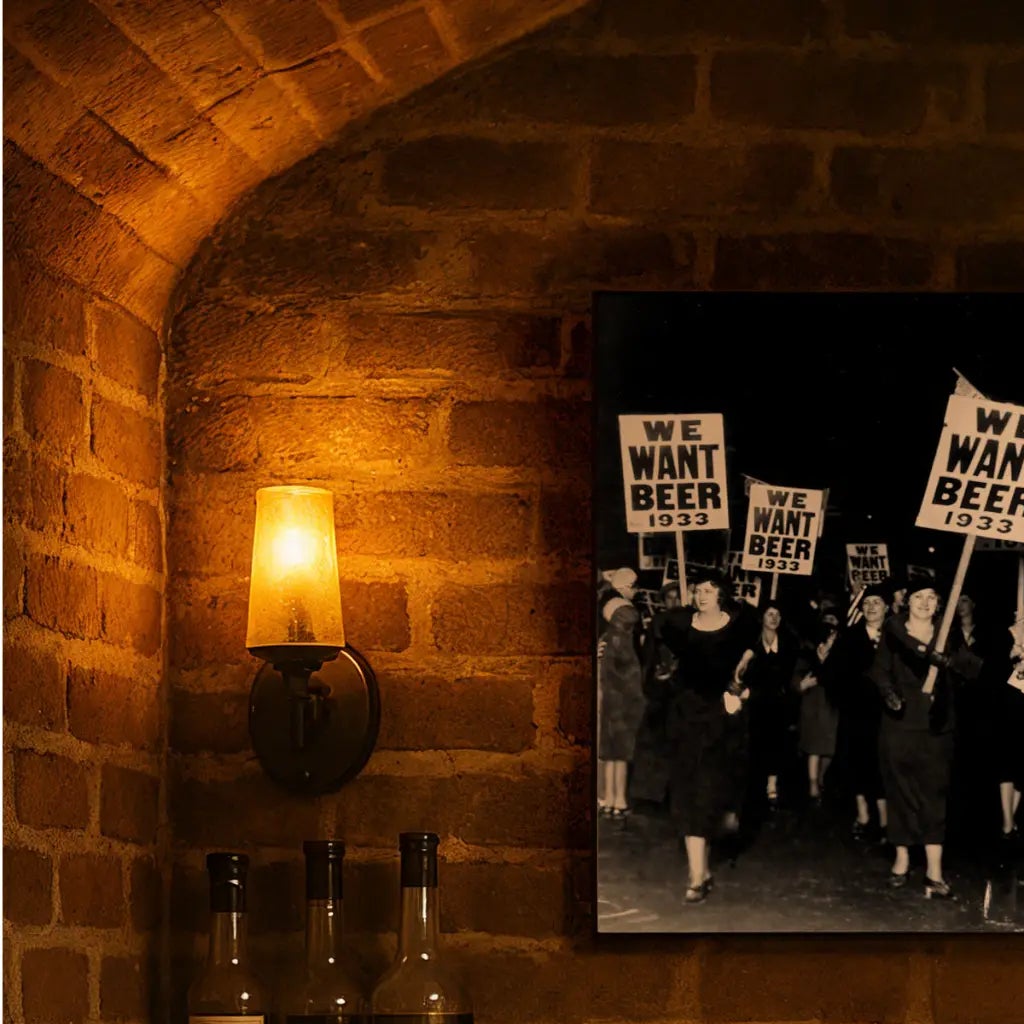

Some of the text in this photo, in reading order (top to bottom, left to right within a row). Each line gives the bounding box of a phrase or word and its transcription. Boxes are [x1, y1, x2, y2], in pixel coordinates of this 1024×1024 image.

[643, 420, 702, 441] WE
[628, 444, 719, 480] WANT
[630, 482, 721, 511] BEER
[767, 489, 807, 509] WE
[649, 512, 709, 528] 1933
[754, 506, 816, 537] WANT
[944, 511, 1014, 534] 1933
[749, 534, 811, 560] BEER
[856, 546, 879, 555] WE
[758, 558, 800, 572] 1933
[850, 556, 886, 568] WANT
